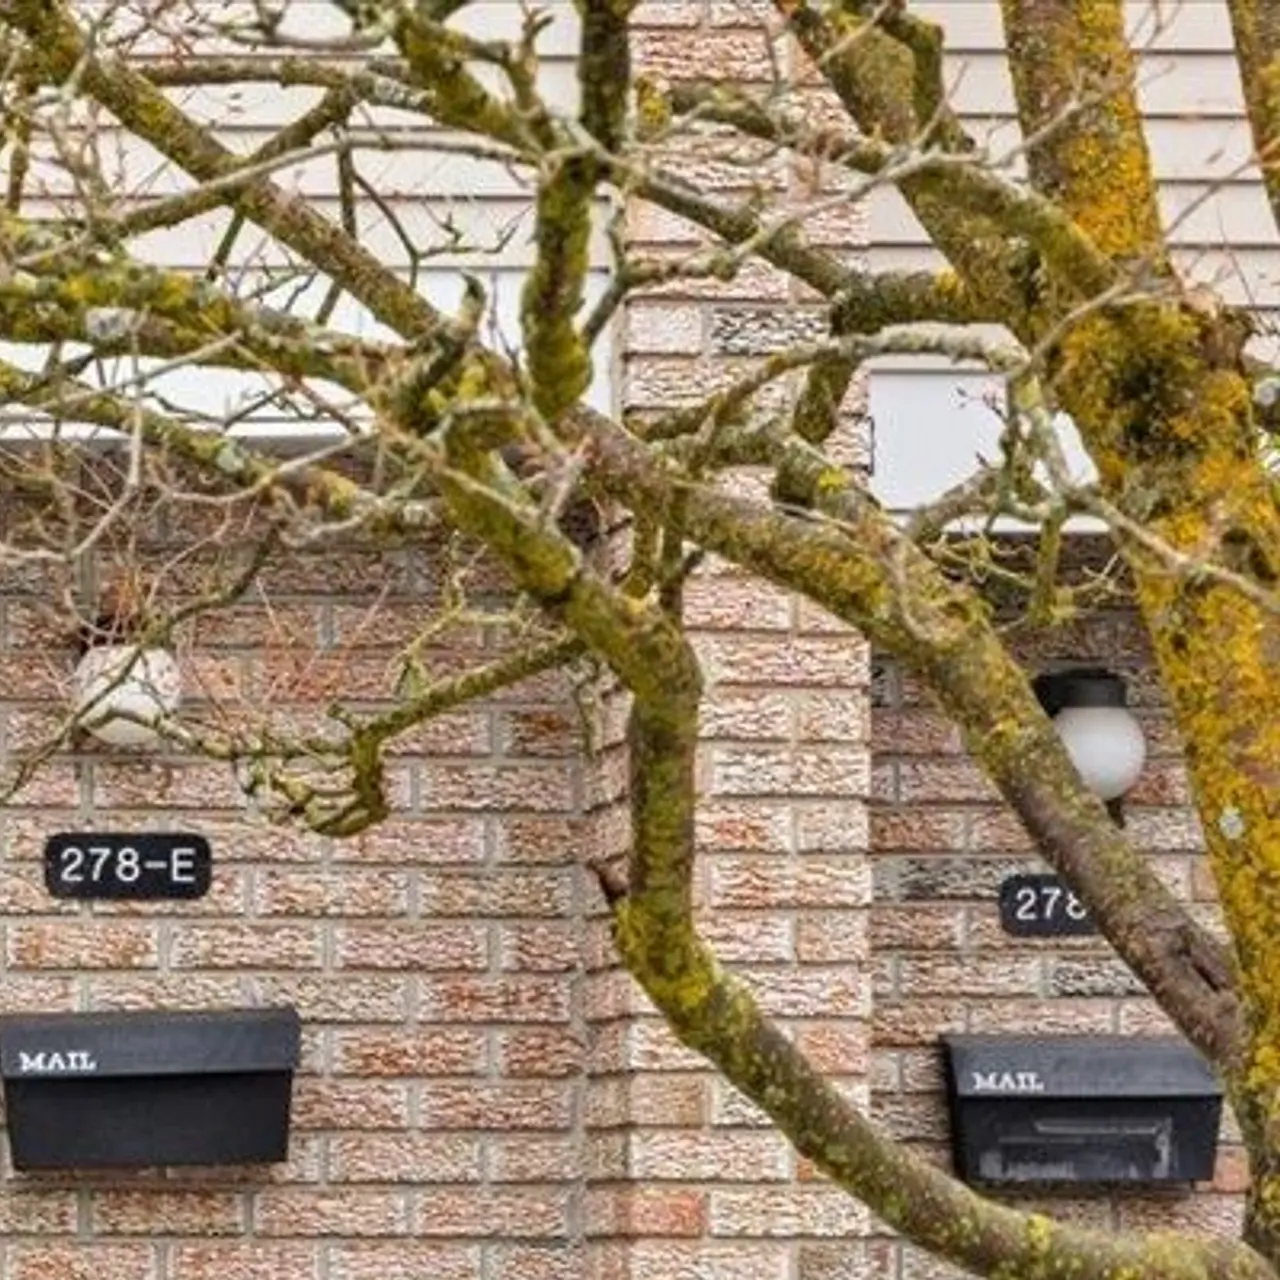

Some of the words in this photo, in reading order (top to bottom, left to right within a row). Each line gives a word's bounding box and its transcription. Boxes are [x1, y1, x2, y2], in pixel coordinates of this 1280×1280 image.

[59, 846, 197, 883] 278-E
[18, 1050, 98, 1073] MAIL
[971, 1070, 1045, 1091] MAIL
